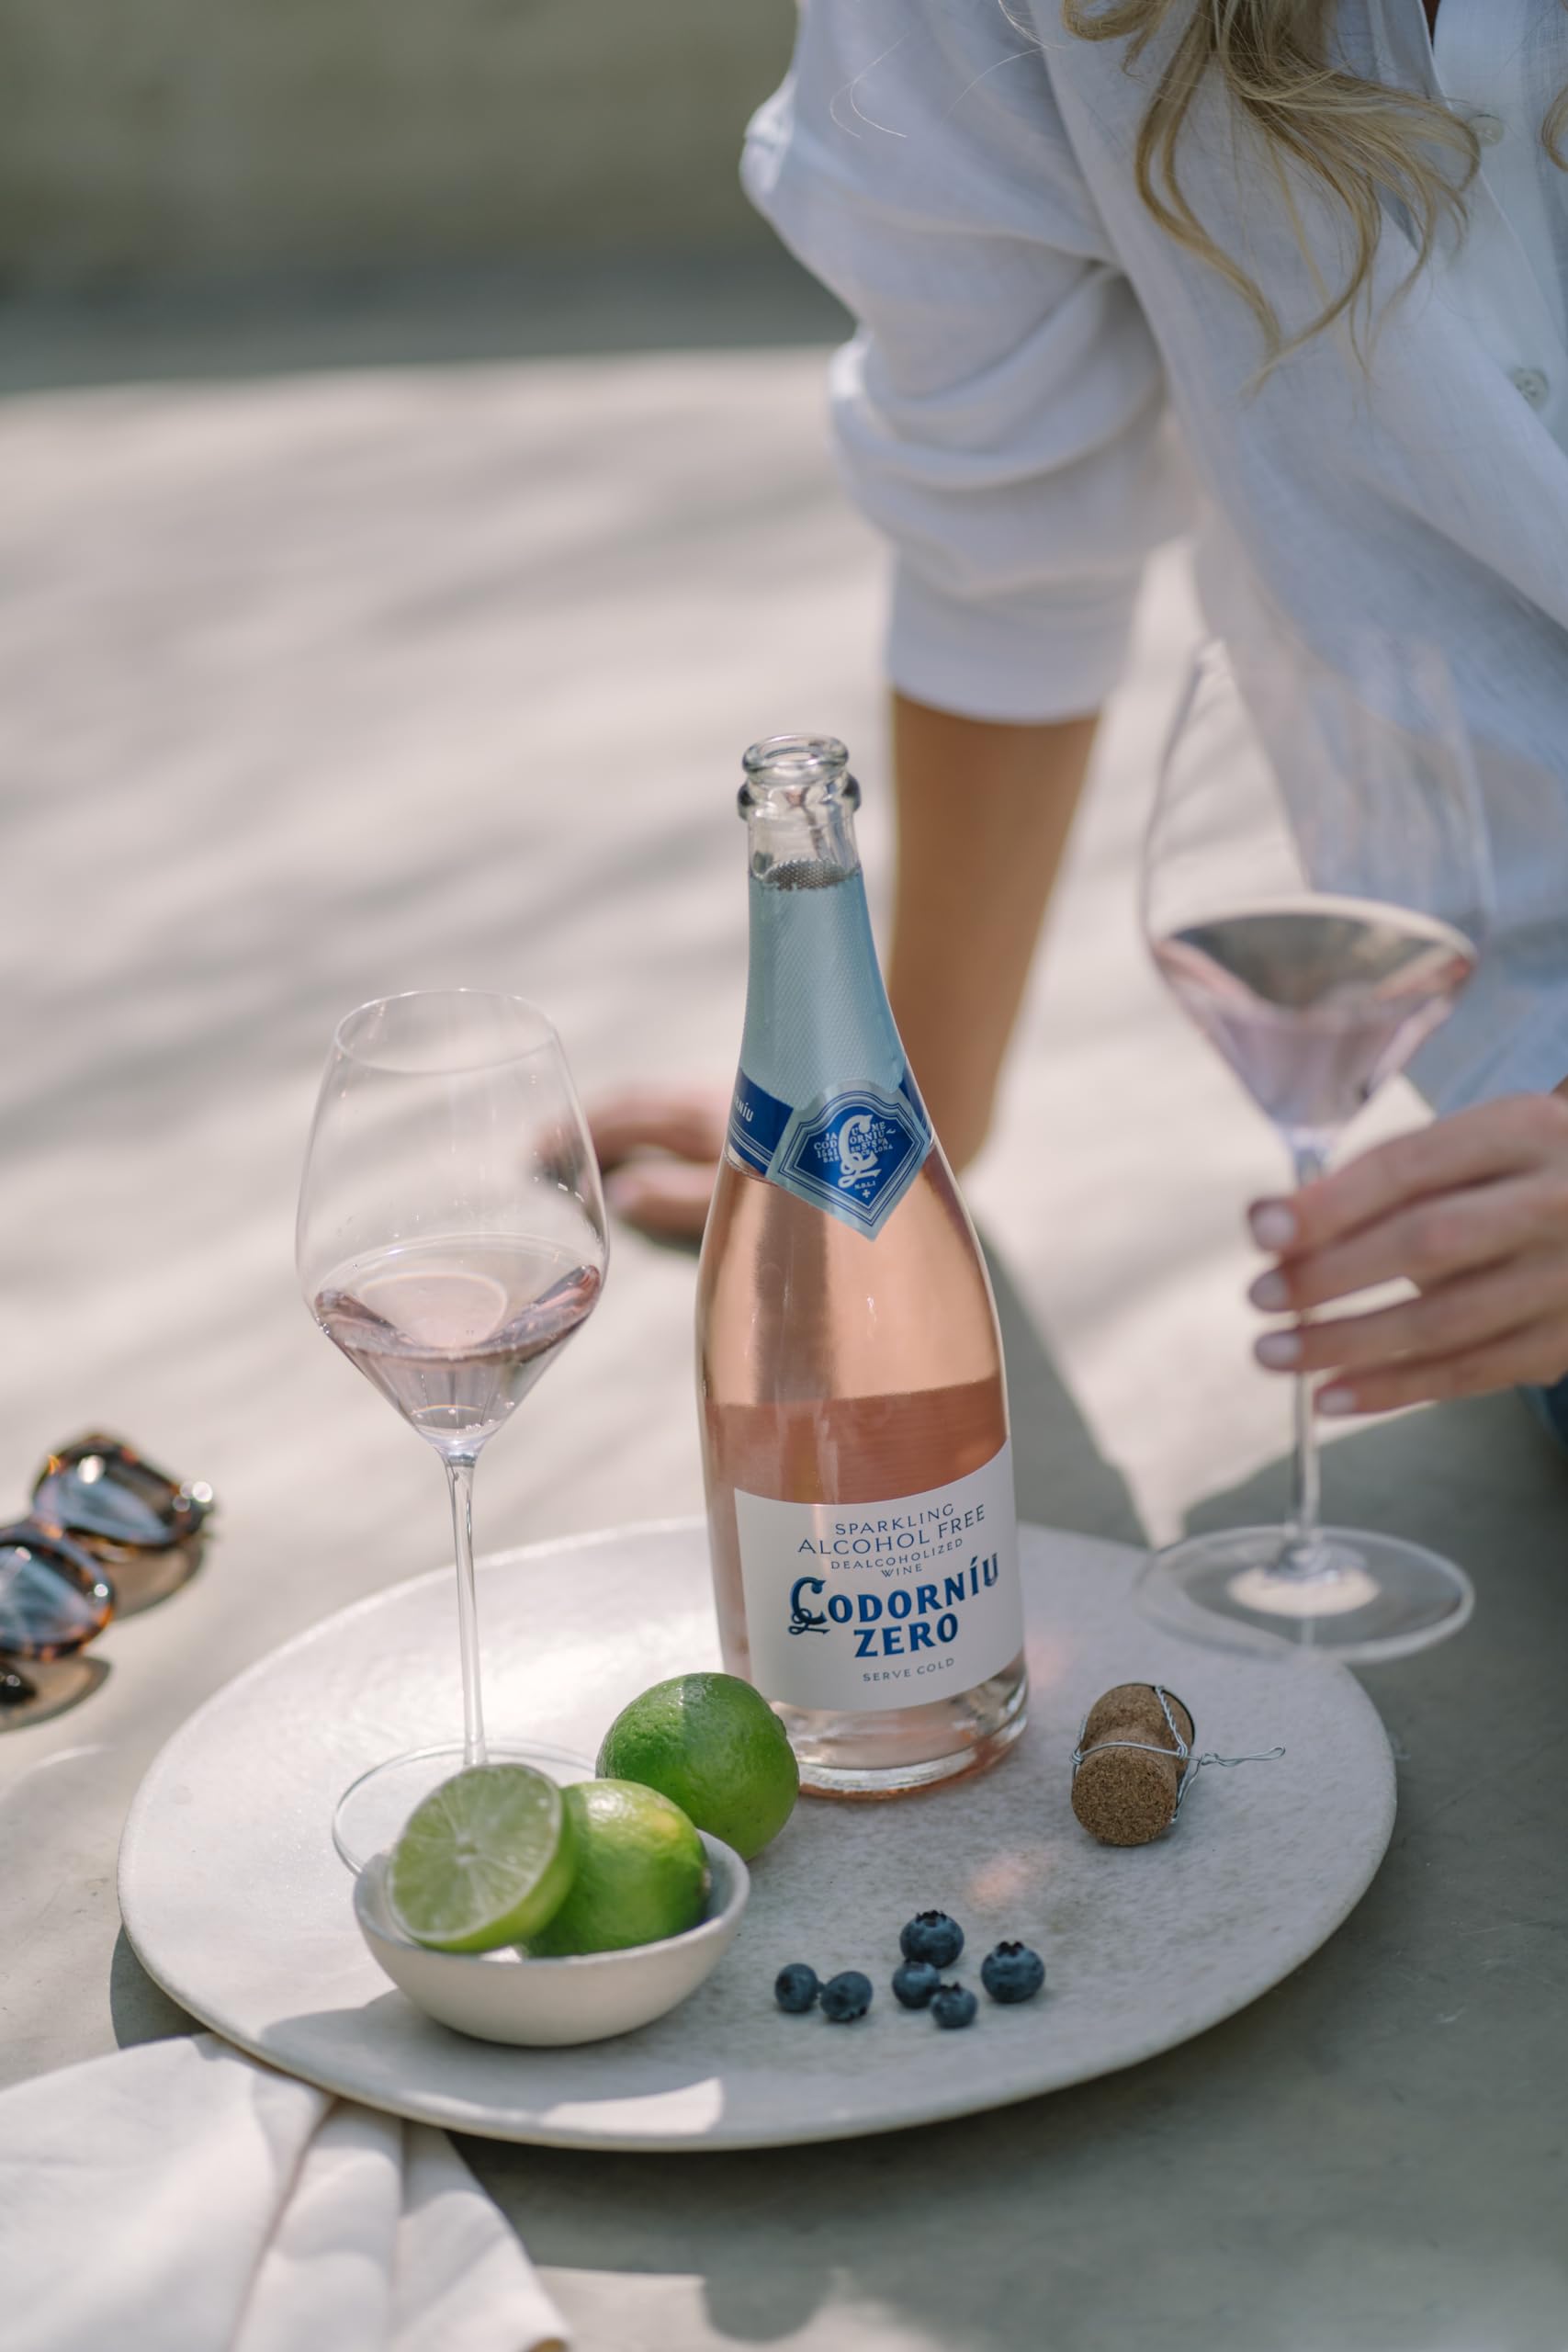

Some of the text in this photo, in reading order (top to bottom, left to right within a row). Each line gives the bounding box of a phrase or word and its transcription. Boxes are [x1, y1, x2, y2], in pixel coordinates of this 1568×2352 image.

[797, 1504, 986, 1555] ALCOHOL FREE
[835, 1503, 954, 1535] SPARKLING
[831, 1538, 964, 1570] DEALCOHOLIZED
[881, 1563, 923, 1578] WINE
[788, 1552, 999, 1636] CODORNÍU
[853, 1613, 959, 1658] ZERO
[863, 1657, 954, 1682] SERVE COLD
